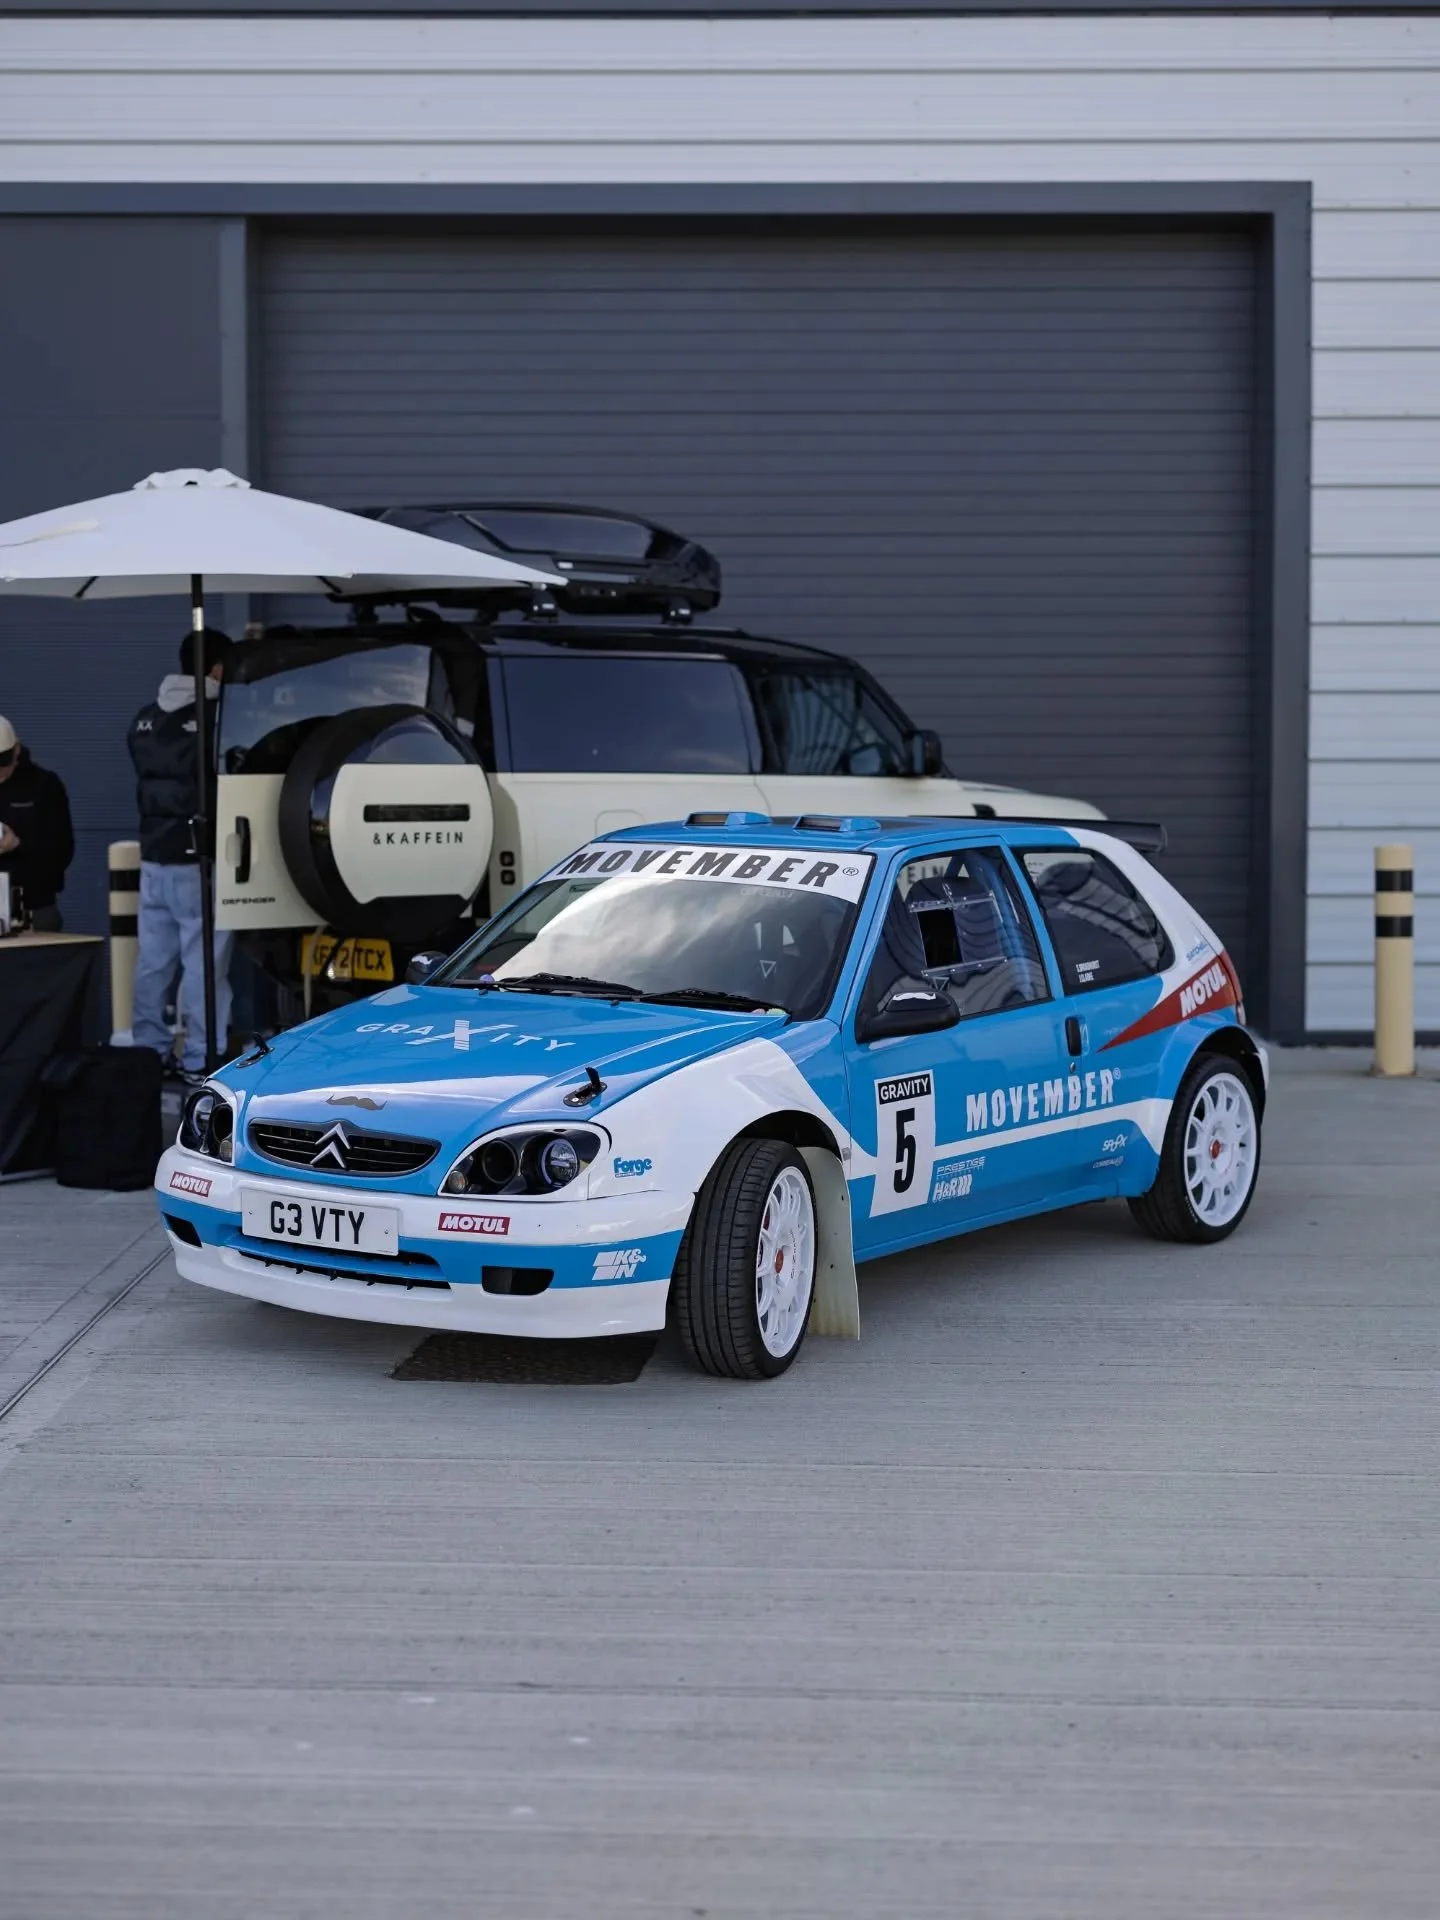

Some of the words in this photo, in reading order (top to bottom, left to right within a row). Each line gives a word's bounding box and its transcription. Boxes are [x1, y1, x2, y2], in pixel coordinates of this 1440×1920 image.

[372, 831, 464, 845] &KAFFEIN
[221, 896, 276, 905] DEFENDER
[1179, 964, 1227, 1018] MOTUL
[879, 1074, 931, 1103] GRAVITY
[892, 1107, 916, 1194] 5
[613, 1156, 653, 1177] Forge
[936, 1156, 986, 1175] PRESTIGE
[171, 1173, 210, 1197] MOTUL
[270, 1200, 303, 1237] G3
[311, 1205, 365, 1245] VTY
[441, 1214, 508, 1234] MOTUL
